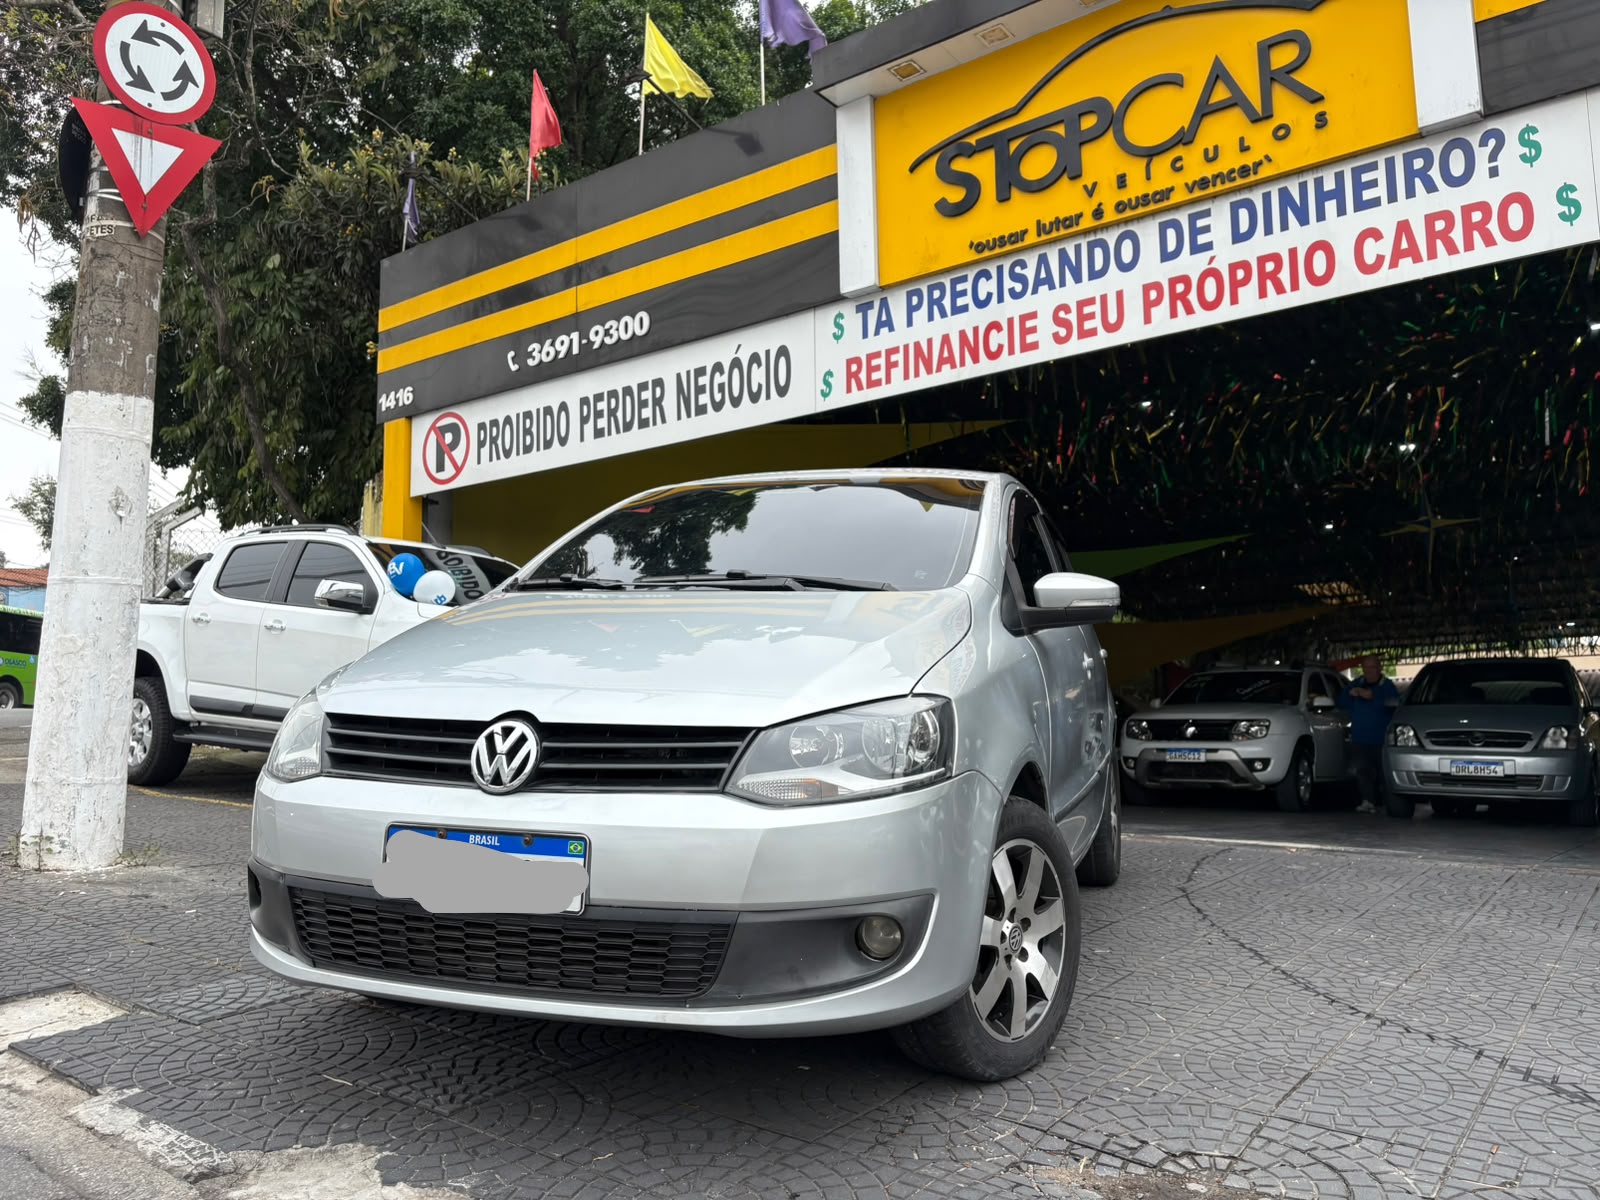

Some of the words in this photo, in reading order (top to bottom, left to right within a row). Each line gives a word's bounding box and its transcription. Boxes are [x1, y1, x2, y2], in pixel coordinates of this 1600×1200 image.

[934, 29, 1325, 218] STOPCAR
[1082, 110, 1328, 199] VEÍCULOS
[856, 296, 895, 340] TA
[905, 229, 1141, 328] PRECISANDO
[1158, 208, 1214, 263] DE
[1230, 128, 1506, 245] DINHEIRO?
[1036, 212, 1083, 236] lutar
[1092, 203, 1105, 221] é
[1114, 183, 1175, 214] ousar
[845, 310, 1039, 394] REFINANCIE
[1051, 289, 1125, 345] SEU
[1142, 239, 1336, 325] PRÓPRIO
[1353, 191, 1535, 276] CARRO
[526, 310, 650, 367] 3691-9300
[379, 386, 414, 412] 1416
[477, 400, 570, 465] PROIBIDO
[579, 377, 666, 443] PERDER
[675, 344, 792, 421] NEGÓCIO
[1455, 765, 1498, 775] DRL8H54
[469, 834, 500, 846] BRASIL
